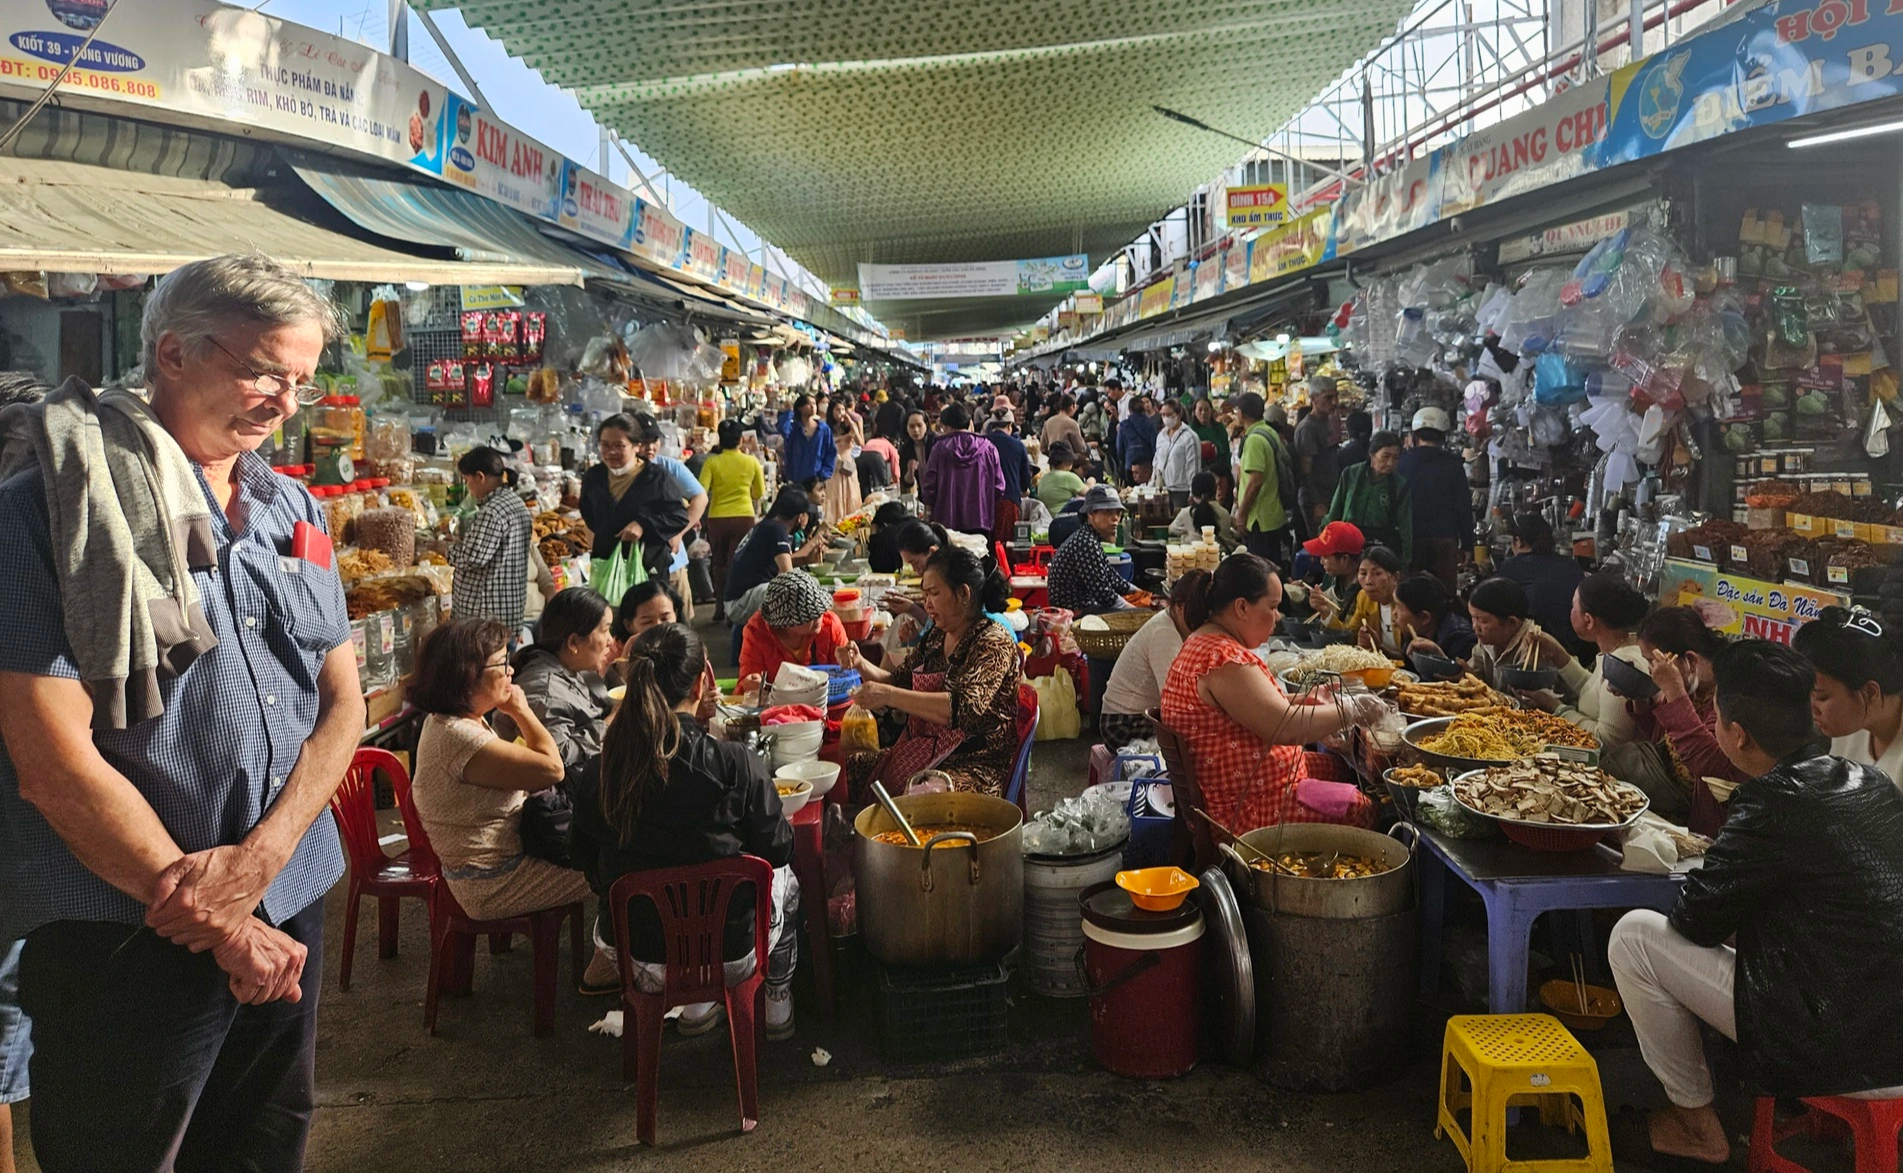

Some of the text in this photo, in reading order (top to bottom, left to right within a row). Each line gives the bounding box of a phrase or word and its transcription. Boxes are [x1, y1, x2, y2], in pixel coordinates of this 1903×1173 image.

[18, 34, 44, 53] KIỐT
[47, 41, 61, 55] 39
[103, 51, 140, 70] VƯƠNG
[1845, 43, 1903, 87] B
[291, 68, 321, 94] PHẨM
[324, 78, 337, 99] ĐÀ
[319, 104, 337, 126] TRÀ
[340, 108, 351, 128] VÀ
[476, 118, 508, 169] KIM
[511, 138, 543, 186] ANH
[1469, 127, 1548, 192] QUANG
[1555, 101, 1608, 153] CHI
[1256, 192, 1275, 207] 15A
[1231, 215, 1246, 224] KHU
[1264, 212, 1283, 223] THỰC
[1717, 580, 1823, 619] Đặc sản Đà Nẵn
